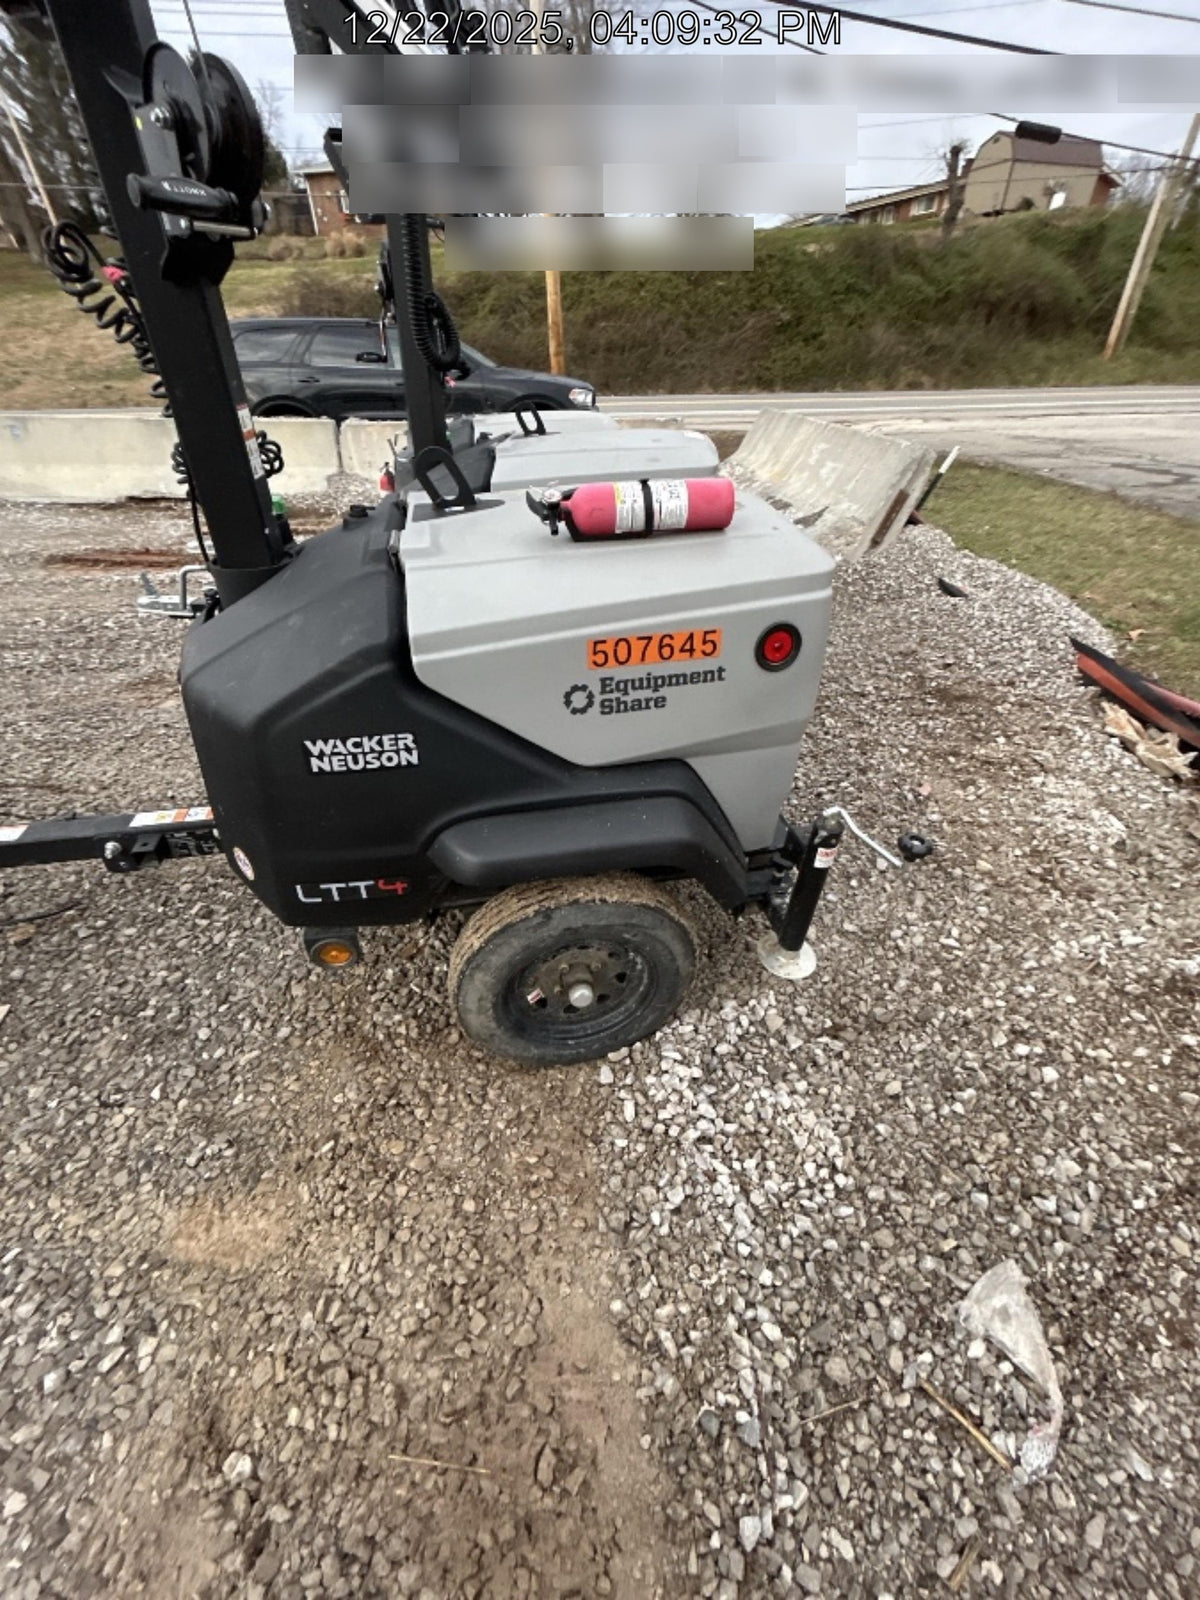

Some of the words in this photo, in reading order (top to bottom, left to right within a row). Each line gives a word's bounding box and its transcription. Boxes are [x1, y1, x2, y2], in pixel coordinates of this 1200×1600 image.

[592, 629, 718, 668] 507645
[599, 665, 727, 696] Equipment
[599, 695, 667, 716] Share
[303, 732, 417, 757] WACKER
[309, 749, 419, 773] NEUSON
[295, 879, 408, 903] LTT4
